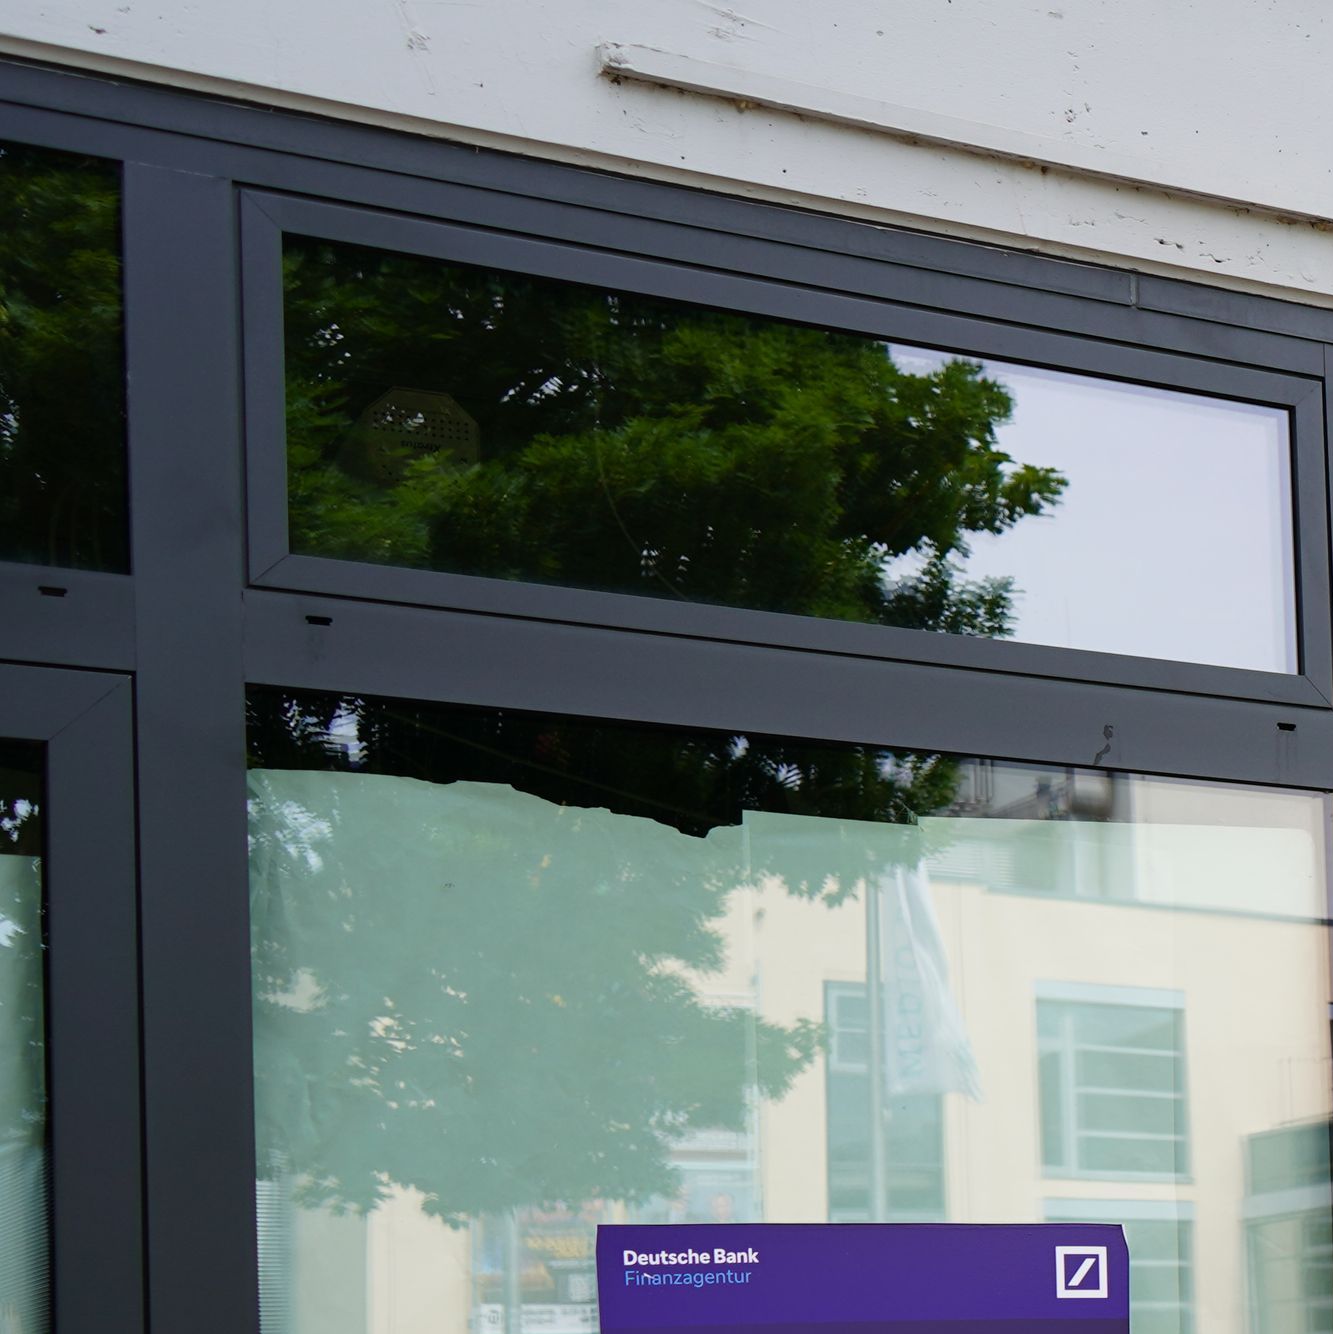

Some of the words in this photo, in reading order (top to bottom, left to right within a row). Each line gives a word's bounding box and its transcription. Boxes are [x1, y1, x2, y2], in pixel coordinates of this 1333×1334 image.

[623, 1248, 710, 1266] Deutsche
[714, 1248, 759, 1264] Bank
[625, 1269, 751, 1287] Finanzagentur
